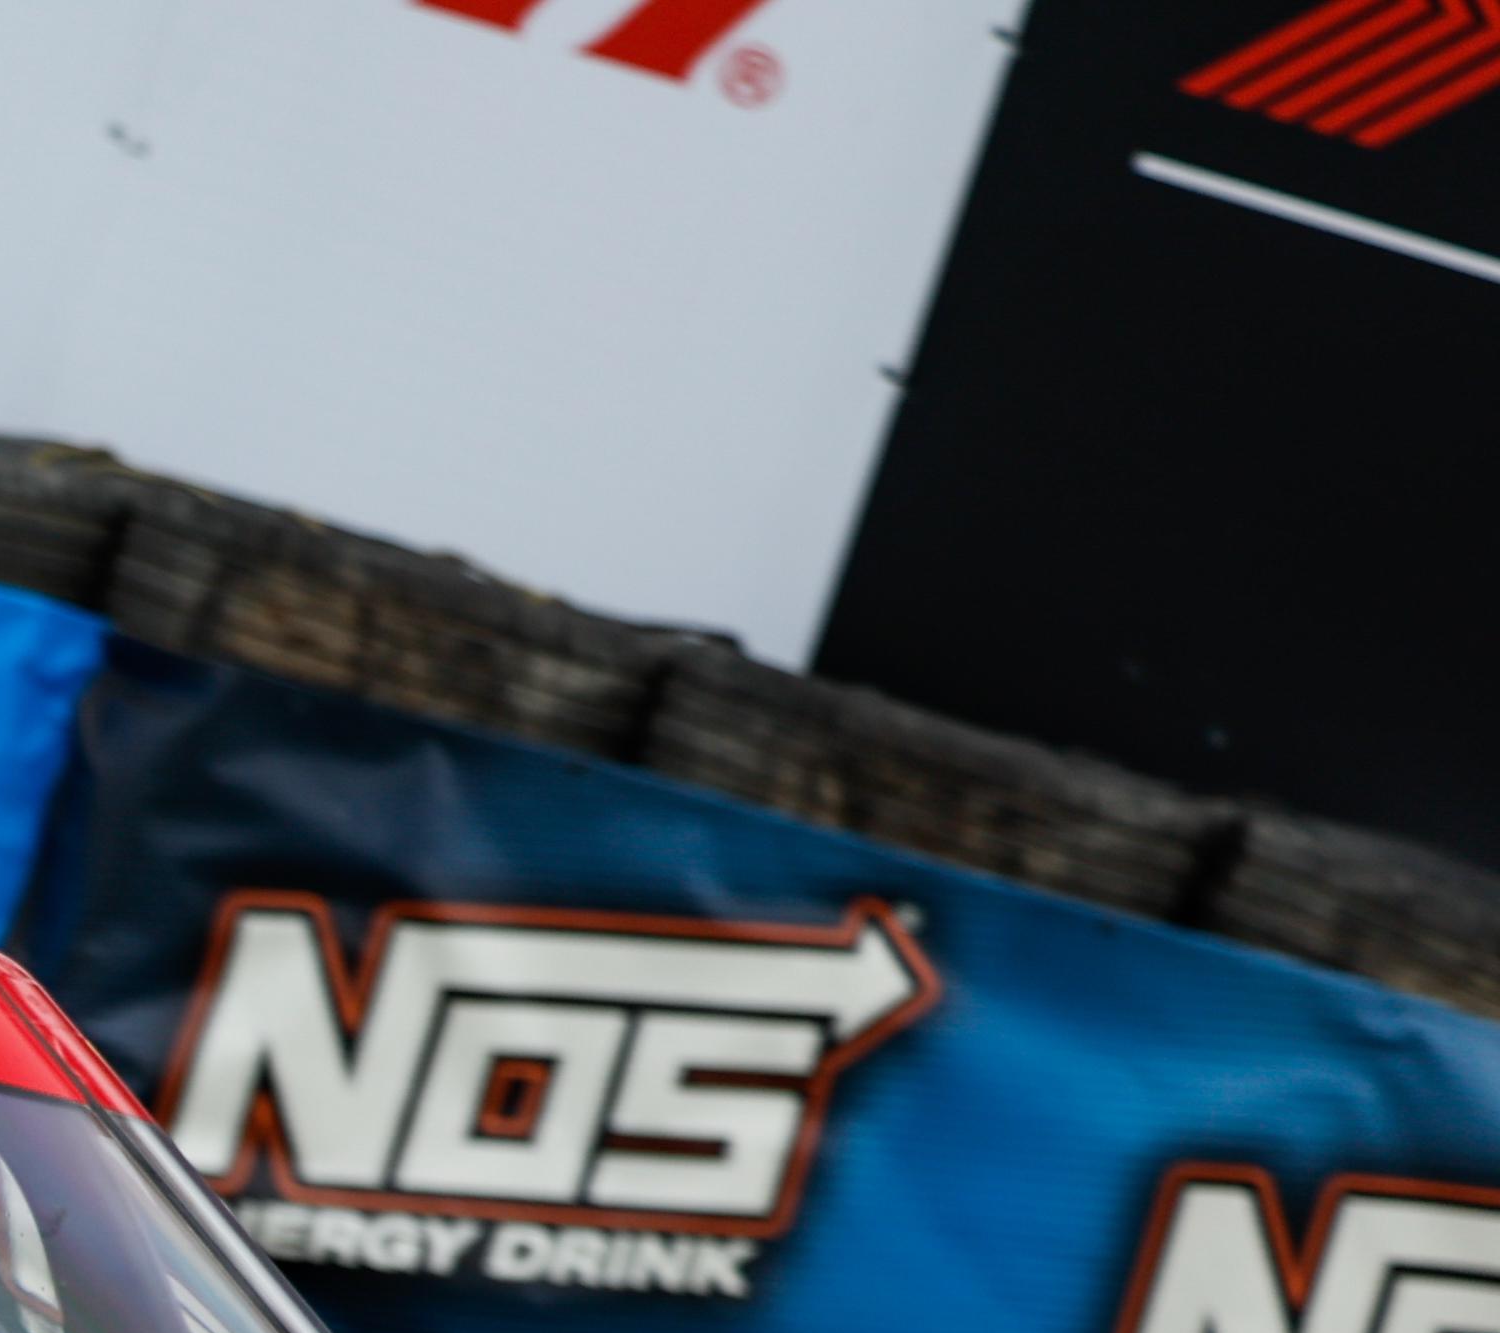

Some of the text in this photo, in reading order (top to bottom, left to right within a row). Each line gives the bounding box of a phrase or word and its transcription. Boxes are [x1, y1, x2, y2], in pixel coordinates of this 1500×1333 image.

[160, 895, 935, 1232] NOS
[239, 1198, 763, 1300] ERGY DRINK
